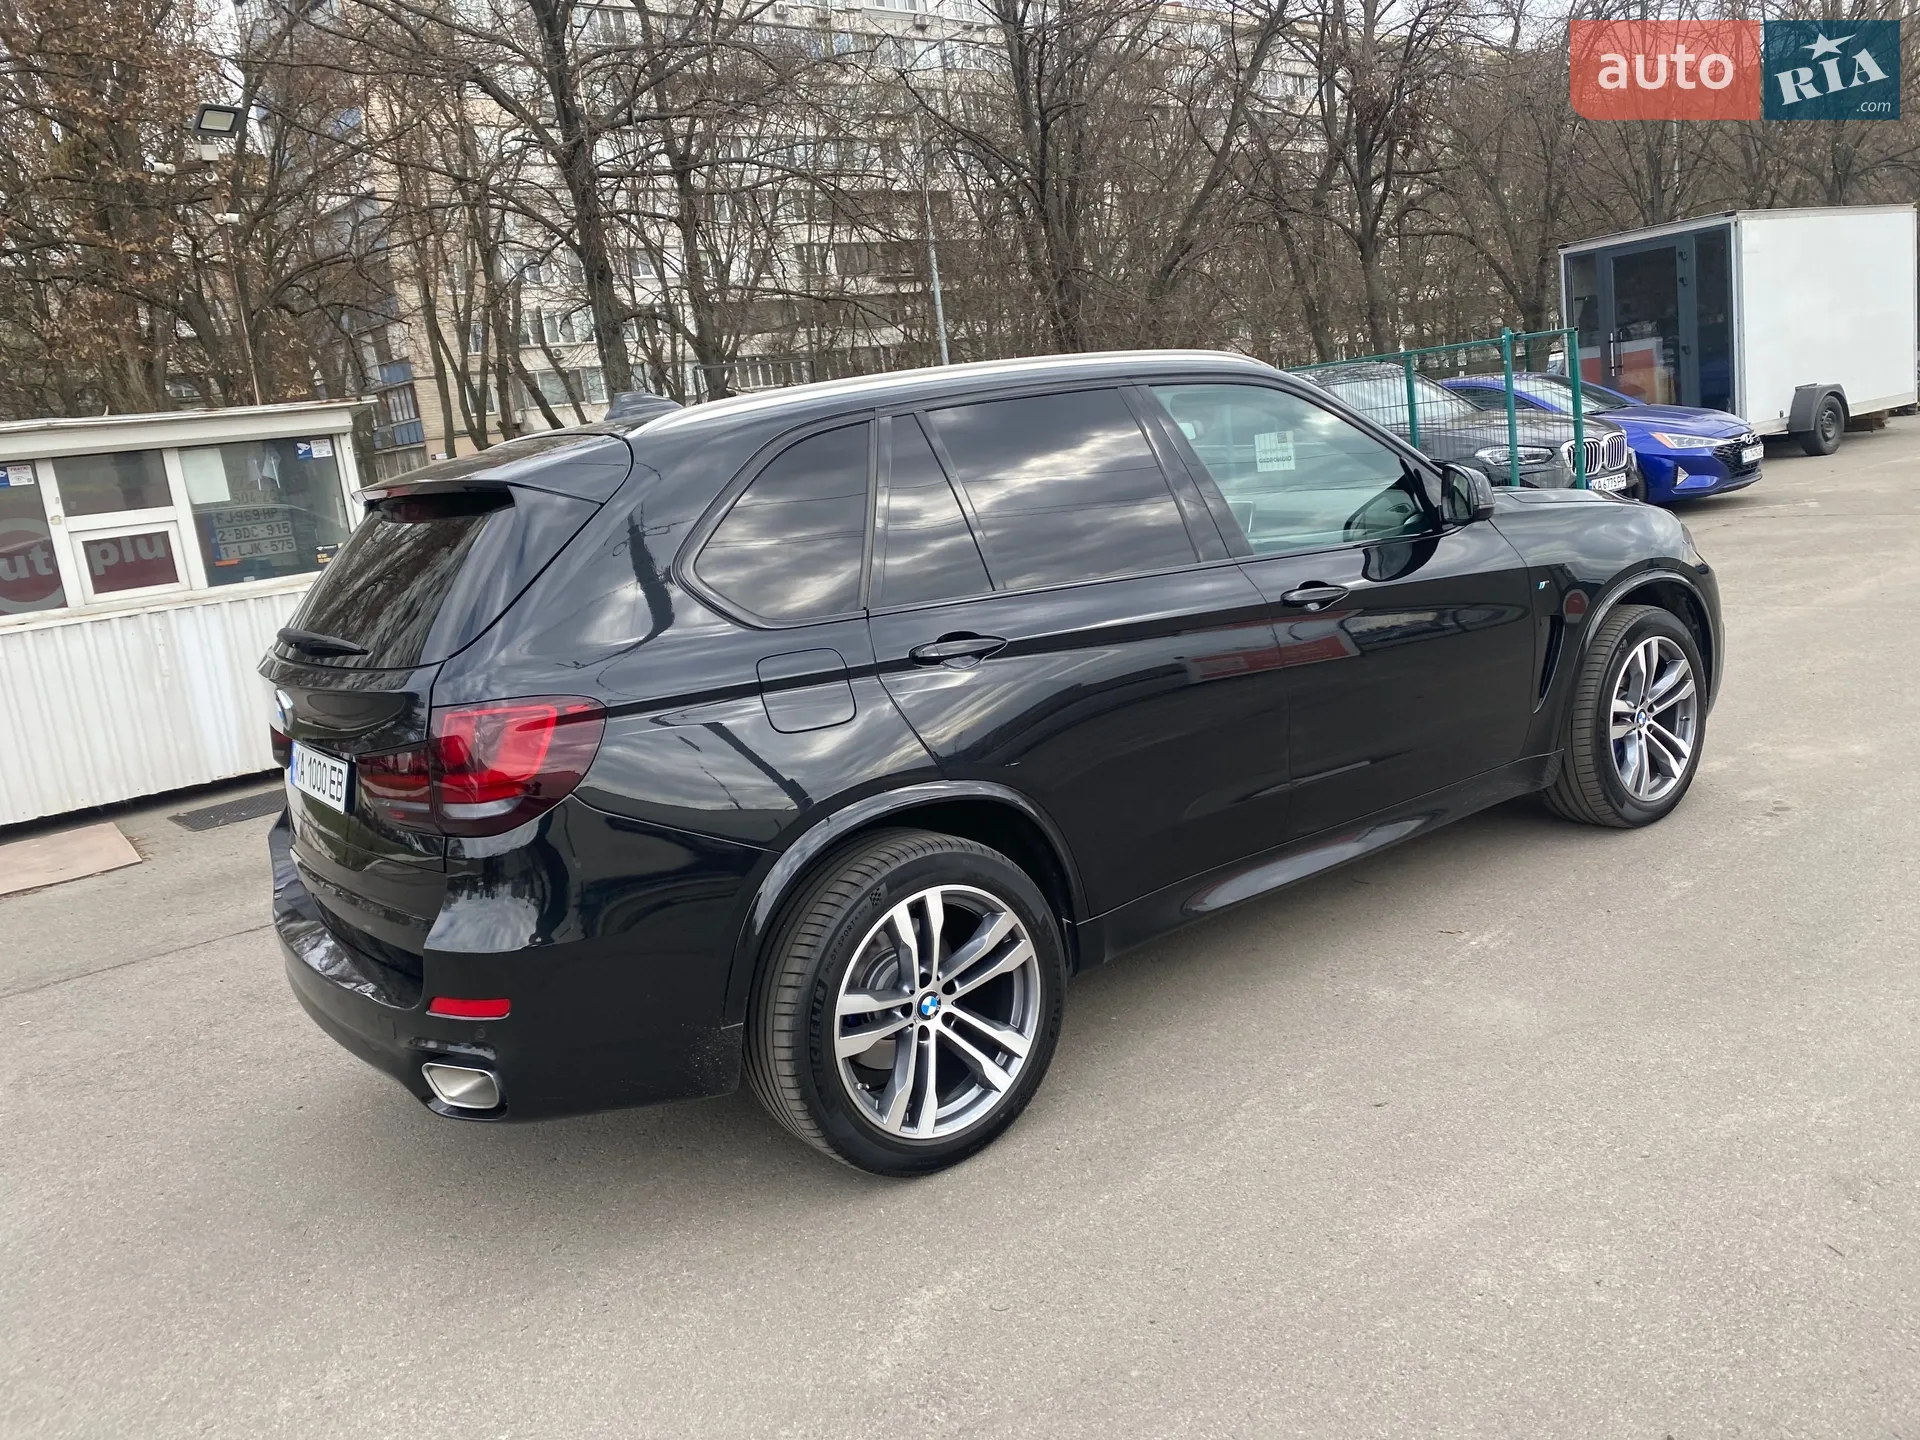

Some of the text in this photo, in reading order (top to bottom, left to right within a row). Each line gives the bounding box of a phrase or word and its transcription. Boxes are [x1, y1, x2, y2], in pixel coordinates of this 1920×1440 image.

[308, 756, 327, 795] 1000
[329, 765, 344, 803] EB
[837, 919, 856, 948] SPORT
